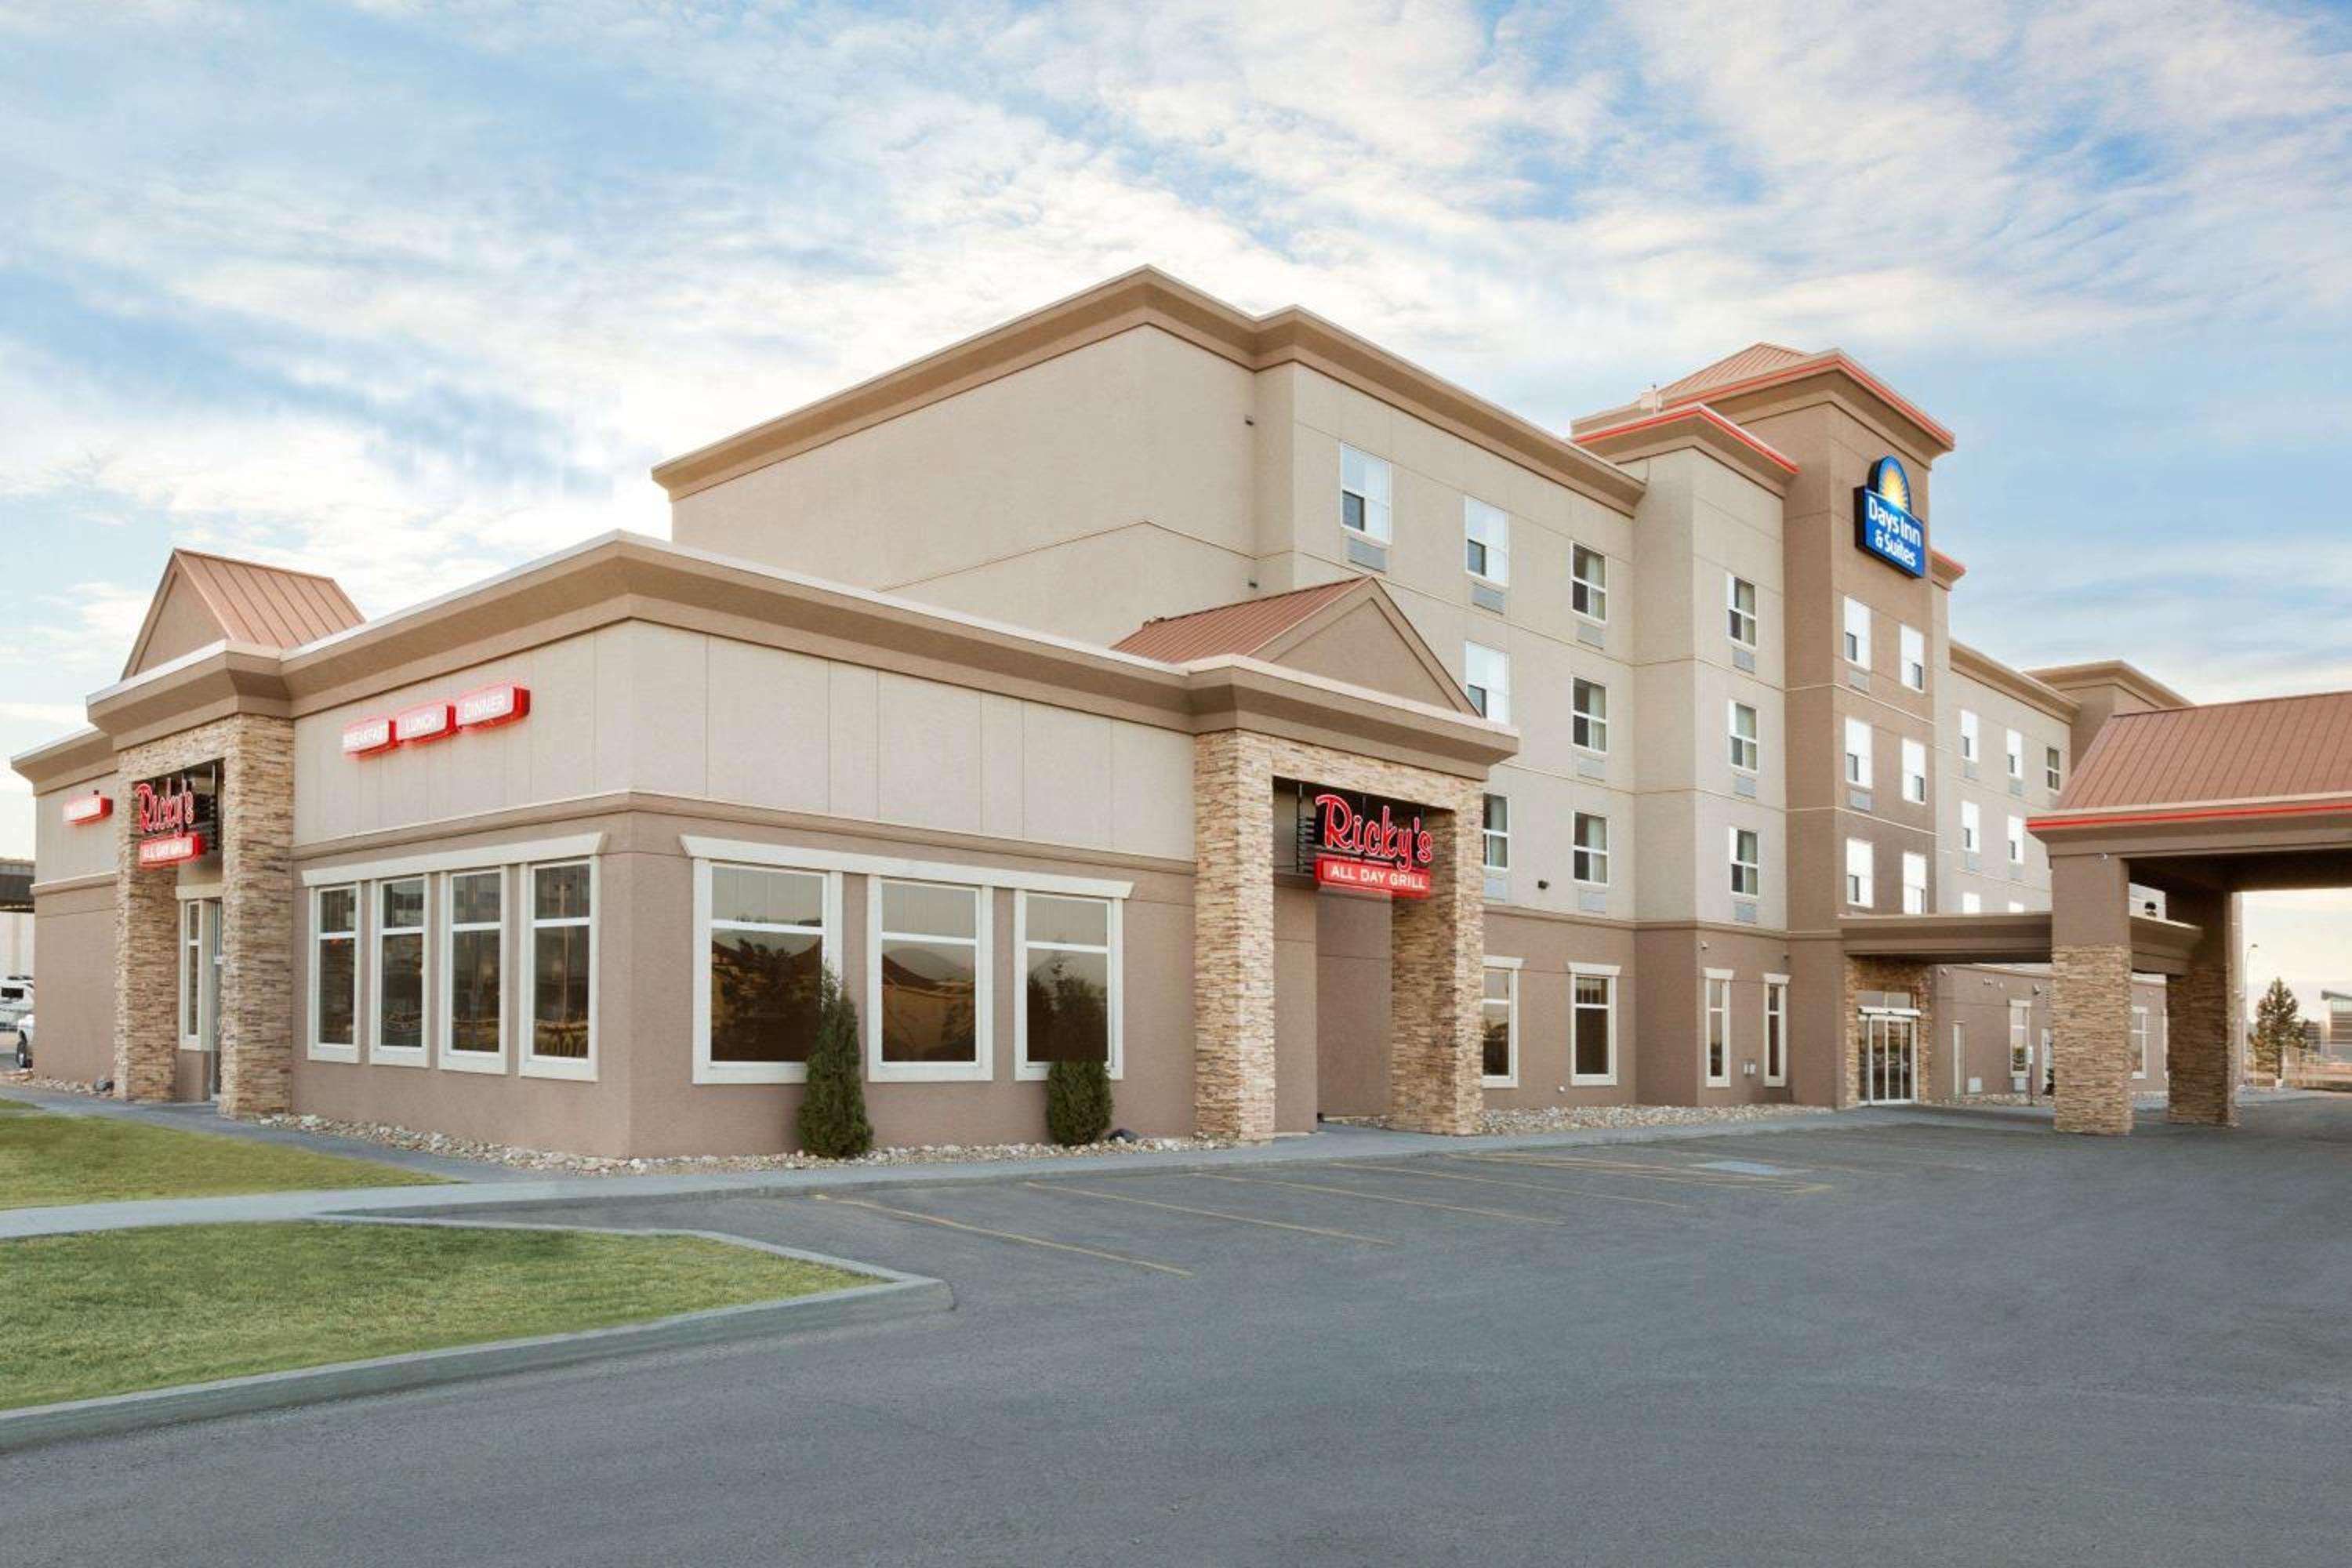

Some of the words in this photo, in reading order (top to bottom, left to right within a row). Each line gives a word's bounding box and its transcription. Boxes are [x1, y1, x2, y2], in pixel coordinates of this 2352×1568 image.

[1868, 496, 1900, 534] Days
[1900, 515, 1921, 547] Inn
[1875, 529, 1884, 550] &
[1884, 533, 1917, 568] Suites
[463, 694, 506, 720] DINNER
[136, 783, 194, 840] Ricky's
[1315, 794, 1432, 872] Ricky's
[1330, 865, 1356, 880] ALL
[1360, 868, 1386, 884] DAY
[1389, 873, 1427, 890] GRILL
